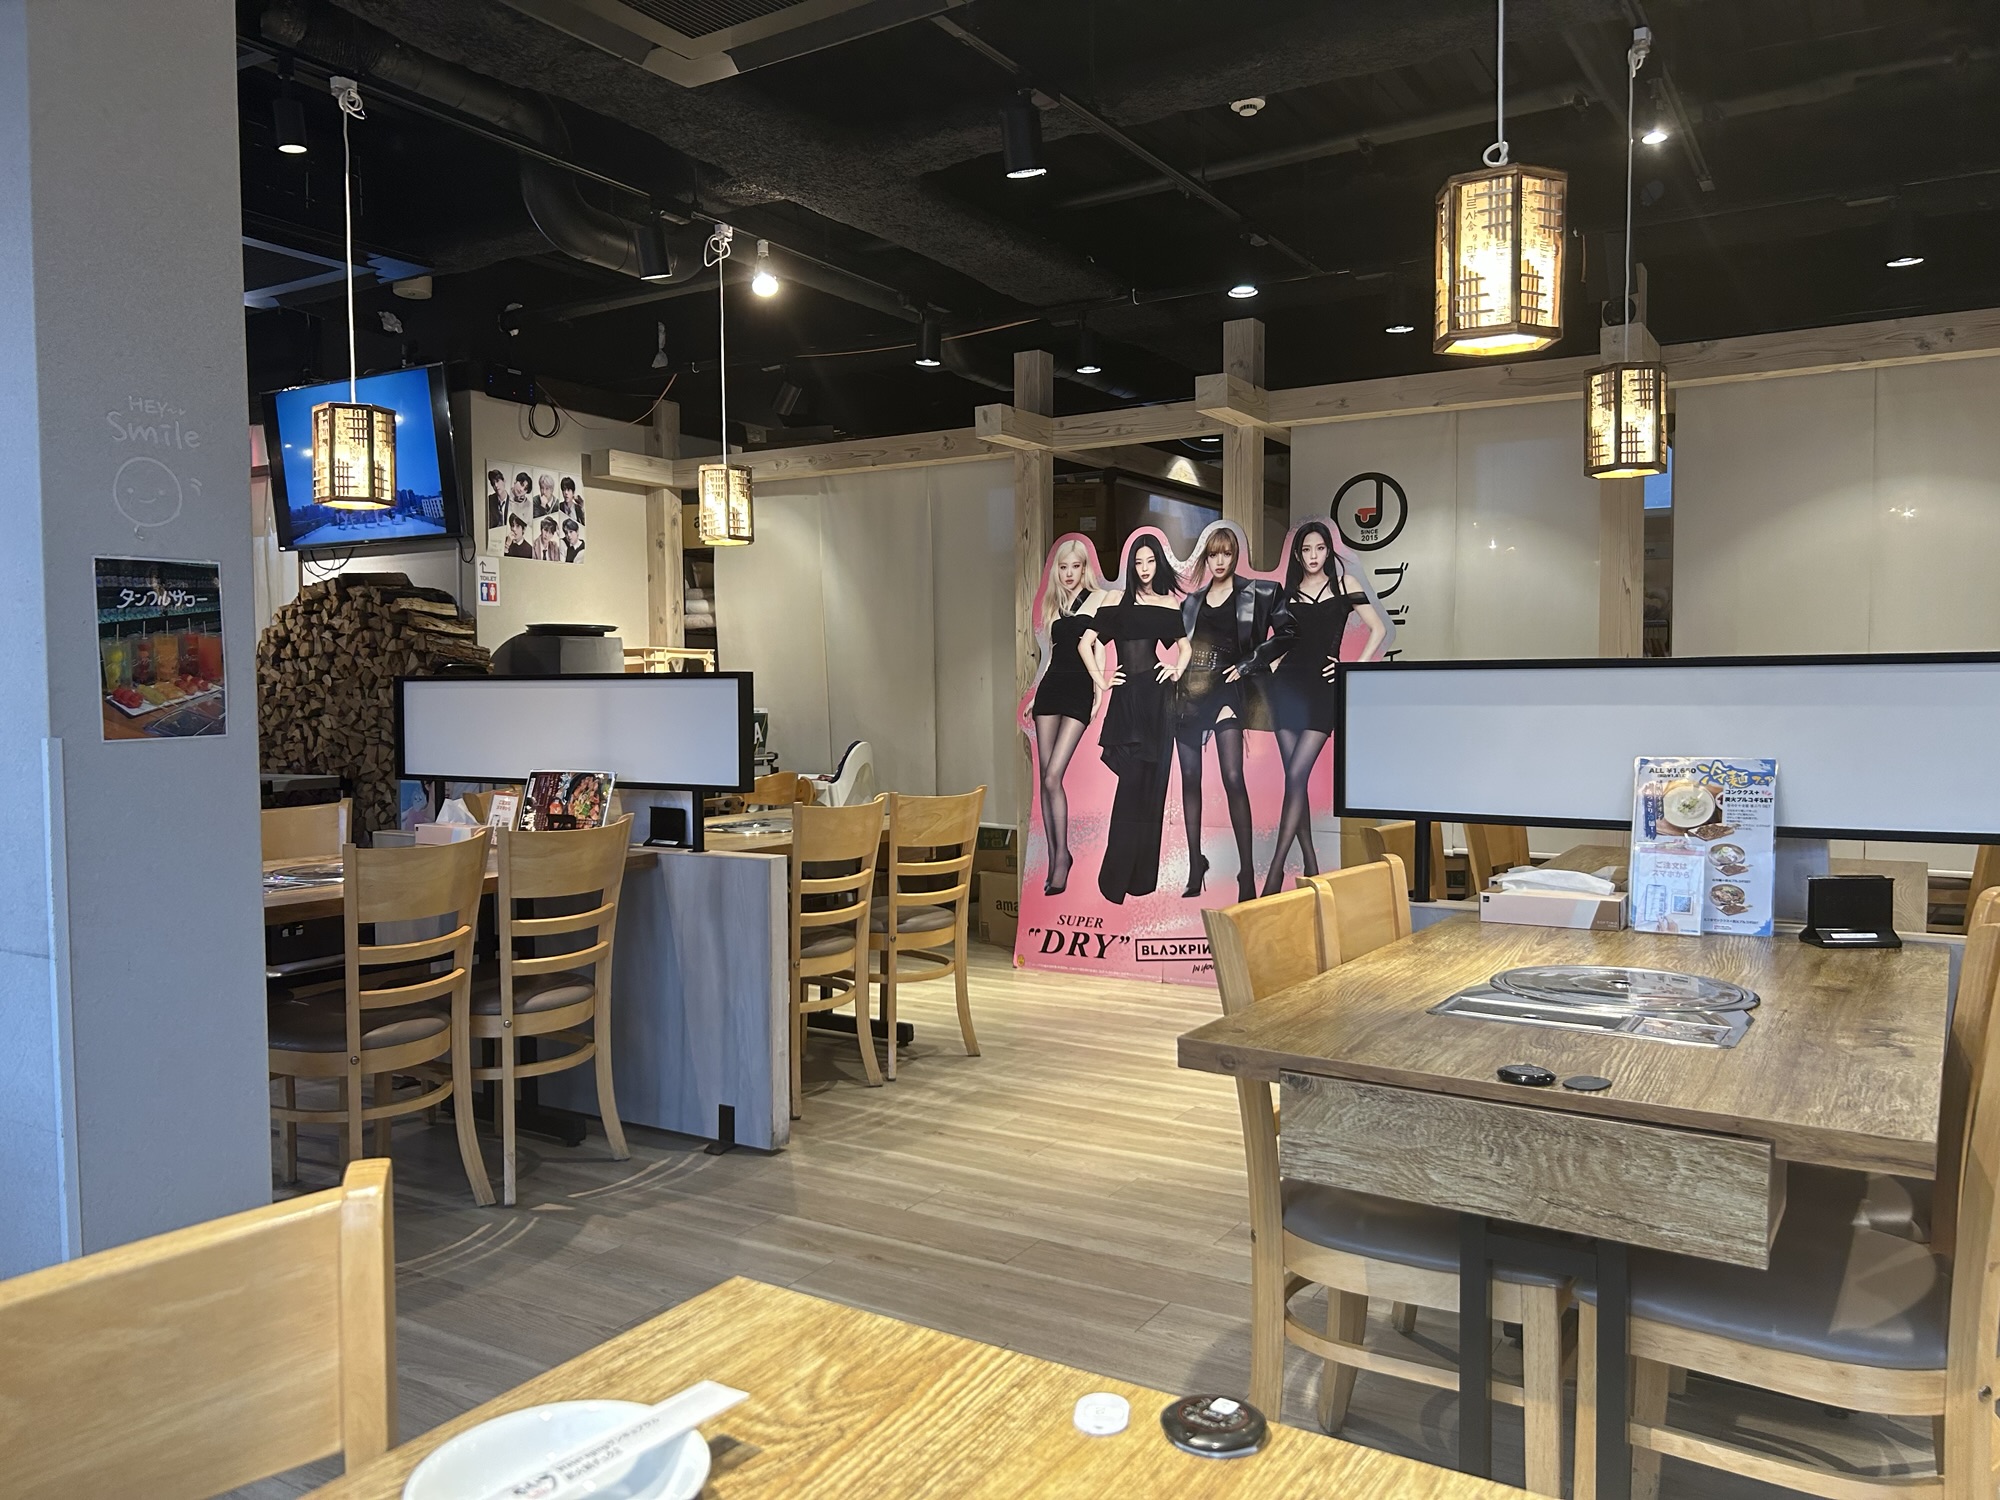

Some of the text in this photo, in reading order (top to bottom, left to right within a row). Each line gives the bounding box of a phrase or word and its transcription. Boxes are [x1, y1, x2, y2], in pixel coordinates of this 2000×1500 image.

[106, 410, 201, 450] Smile
[1361, 534, 1379, 542] 2015
[1655, 861, 1688, 870] ご注文は
[1652, 869, 1690, 879] スマホから
[1057, 914, 1104, 929] SUPER
